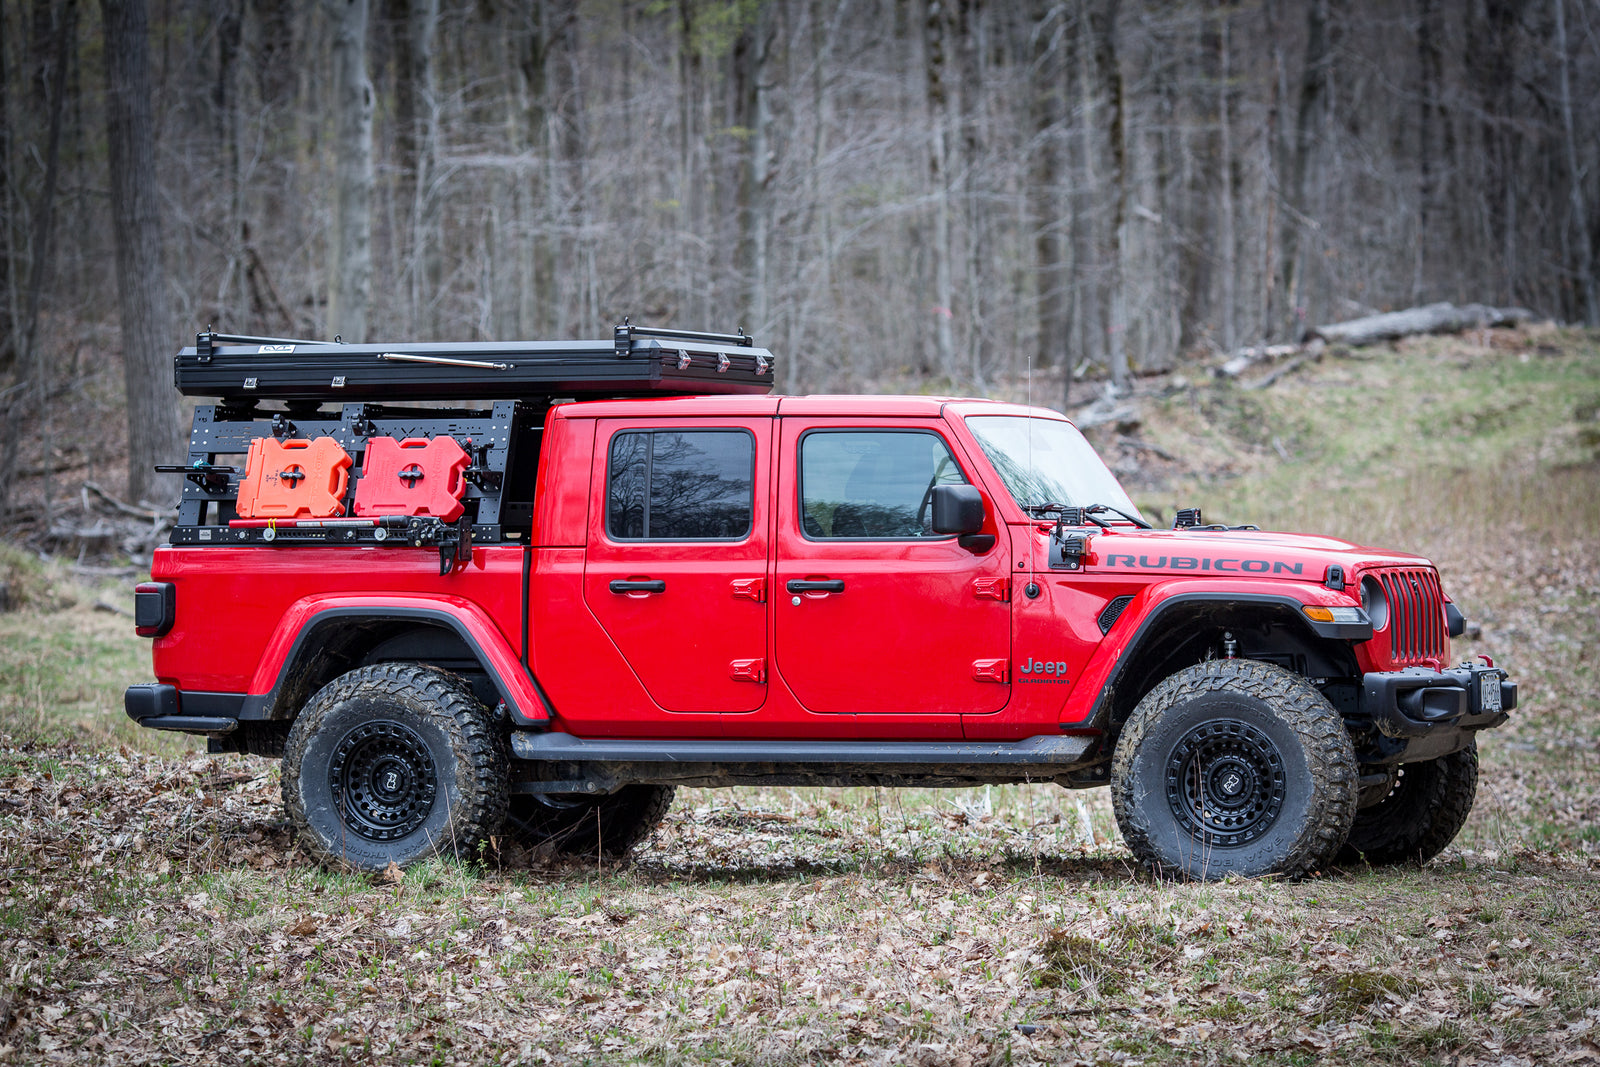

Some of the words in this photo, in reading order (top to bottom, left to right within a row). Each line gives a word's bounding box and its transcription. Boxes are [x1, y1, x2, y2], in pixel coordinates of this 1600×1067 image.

[1106, 554, 1304, 575] RUBICON
[1020, 657, 1067, 677] Jeep
[1244, 836, 1285, 863] BAJA
